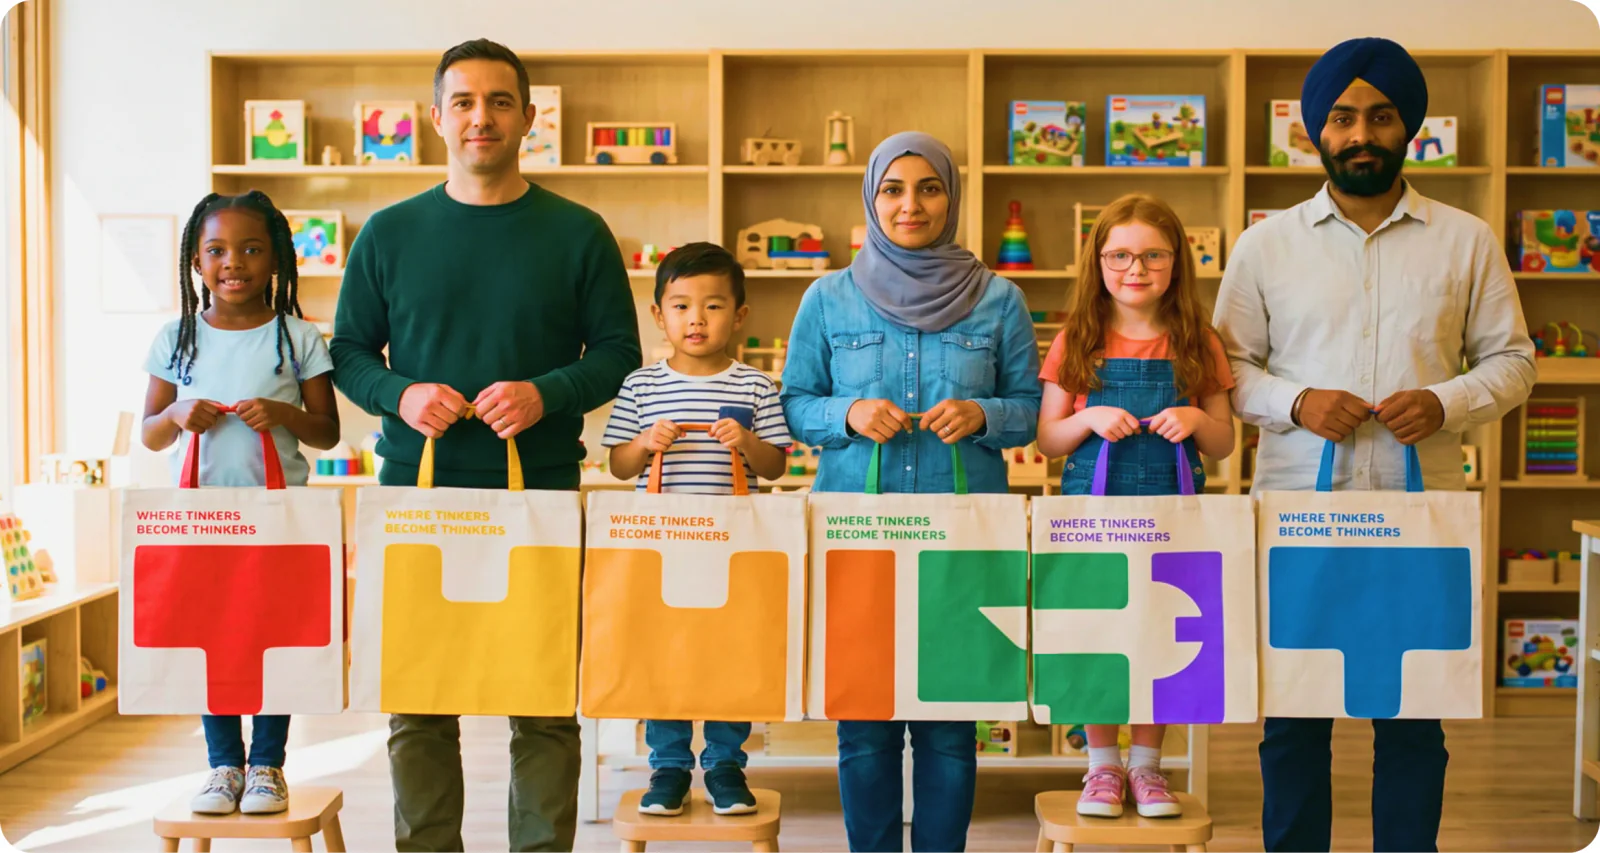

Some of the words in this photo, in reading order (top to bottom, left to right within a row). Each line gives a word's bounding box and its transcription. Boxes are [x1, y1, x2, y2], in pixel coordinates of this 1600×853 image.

[137, 511, 181, 520] WHERE
[186, 511, 241, 521] TINKERS
[385, 510, 431, 520] WHERE
[435, 510, 490, 522] TINKERS
[610, 515, 656, 525] WHERE
[660, 516, 714, 527] TINKERS
[826, 516, 873, 525] WHERE
[876, 516, 930, 526] TINKERS
[1279, 513, 1325, 522] WHERE
[1329, 513, 1384, 523] TINKERS
[1050, 519, 1096, 528] WHERE
[1100, 519, 1155, 529] TINKERS
[137, 525, 188, 535] BECOME
[192, 525, 256, 535] THINKERS
[384, 523, 437, 535] BECOME
[440, 524, 506, 536] THINKERS
[1279, 527, 1332, 536] BECOME
[1336, 527, 1400, 537] THINKERS
[610, 529, 661, 540] BECOME
[664, 530, 730, 541] THINKERS
[826, 530, 878, 540] BECOME
[882, 530, 947, 540] THINKERS
[1050, 532, 1102, 542] BECOME
[1106, 532, 1171, 542] THINKERS
